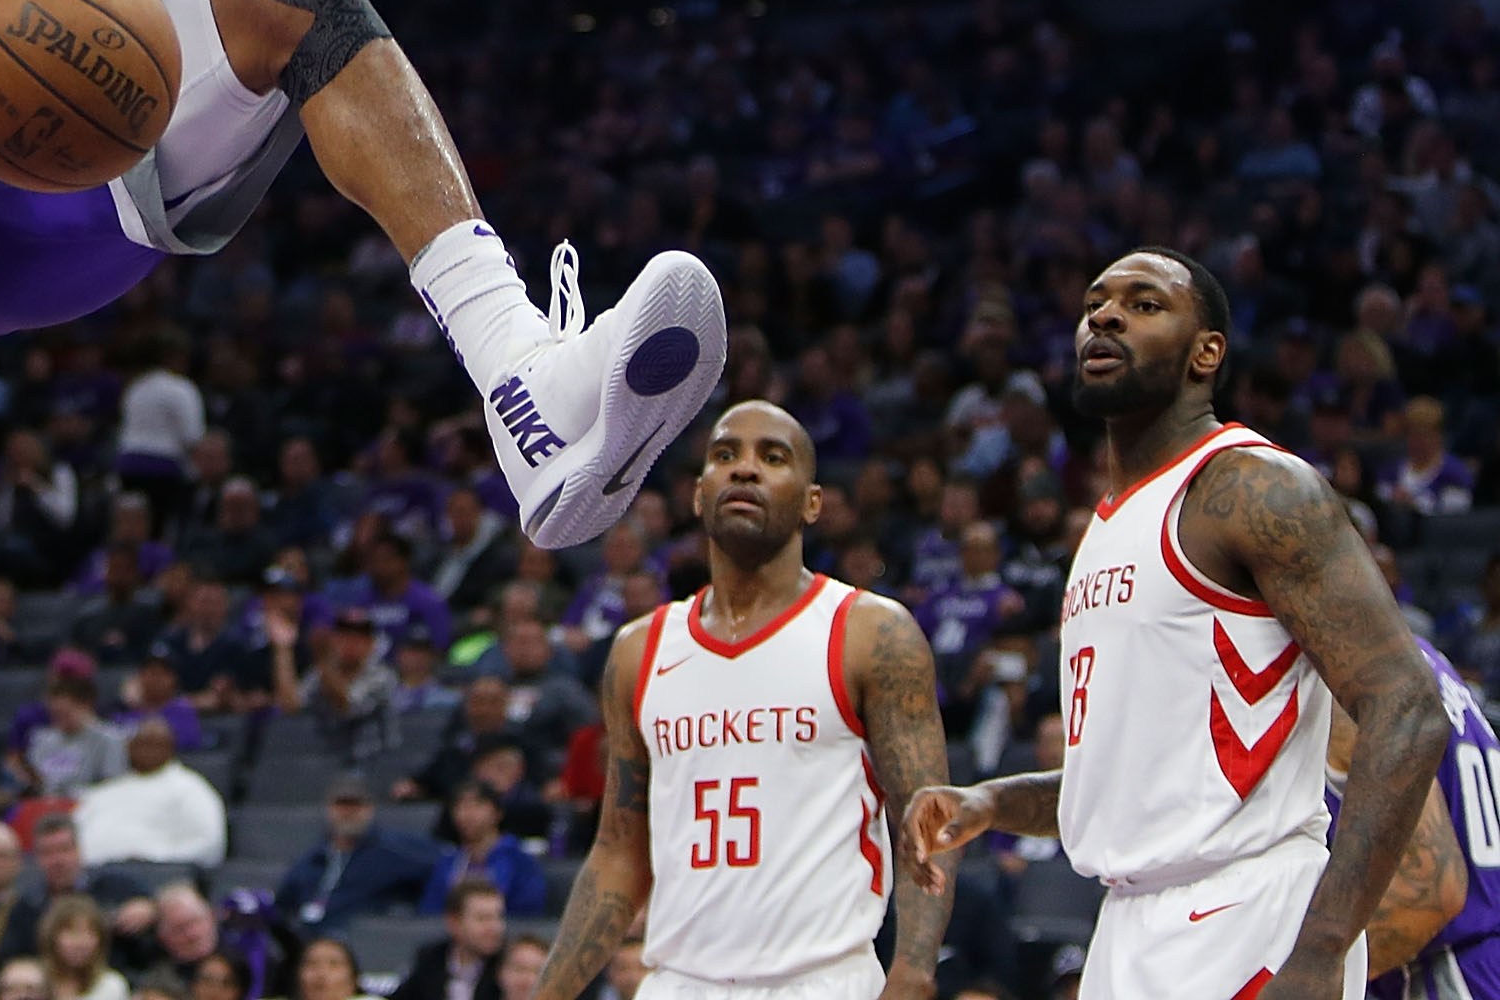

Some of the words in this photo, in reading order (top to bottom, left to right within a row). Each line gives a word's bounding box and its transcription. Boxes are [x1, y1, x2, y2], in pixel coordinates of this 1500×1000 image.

[6, 0, 158, 139] SPALDING
[489, 375, 567, 468] NIKE
[653, 706, 818, 758] ROCKETS
[691, 776, 760, 869] 55
